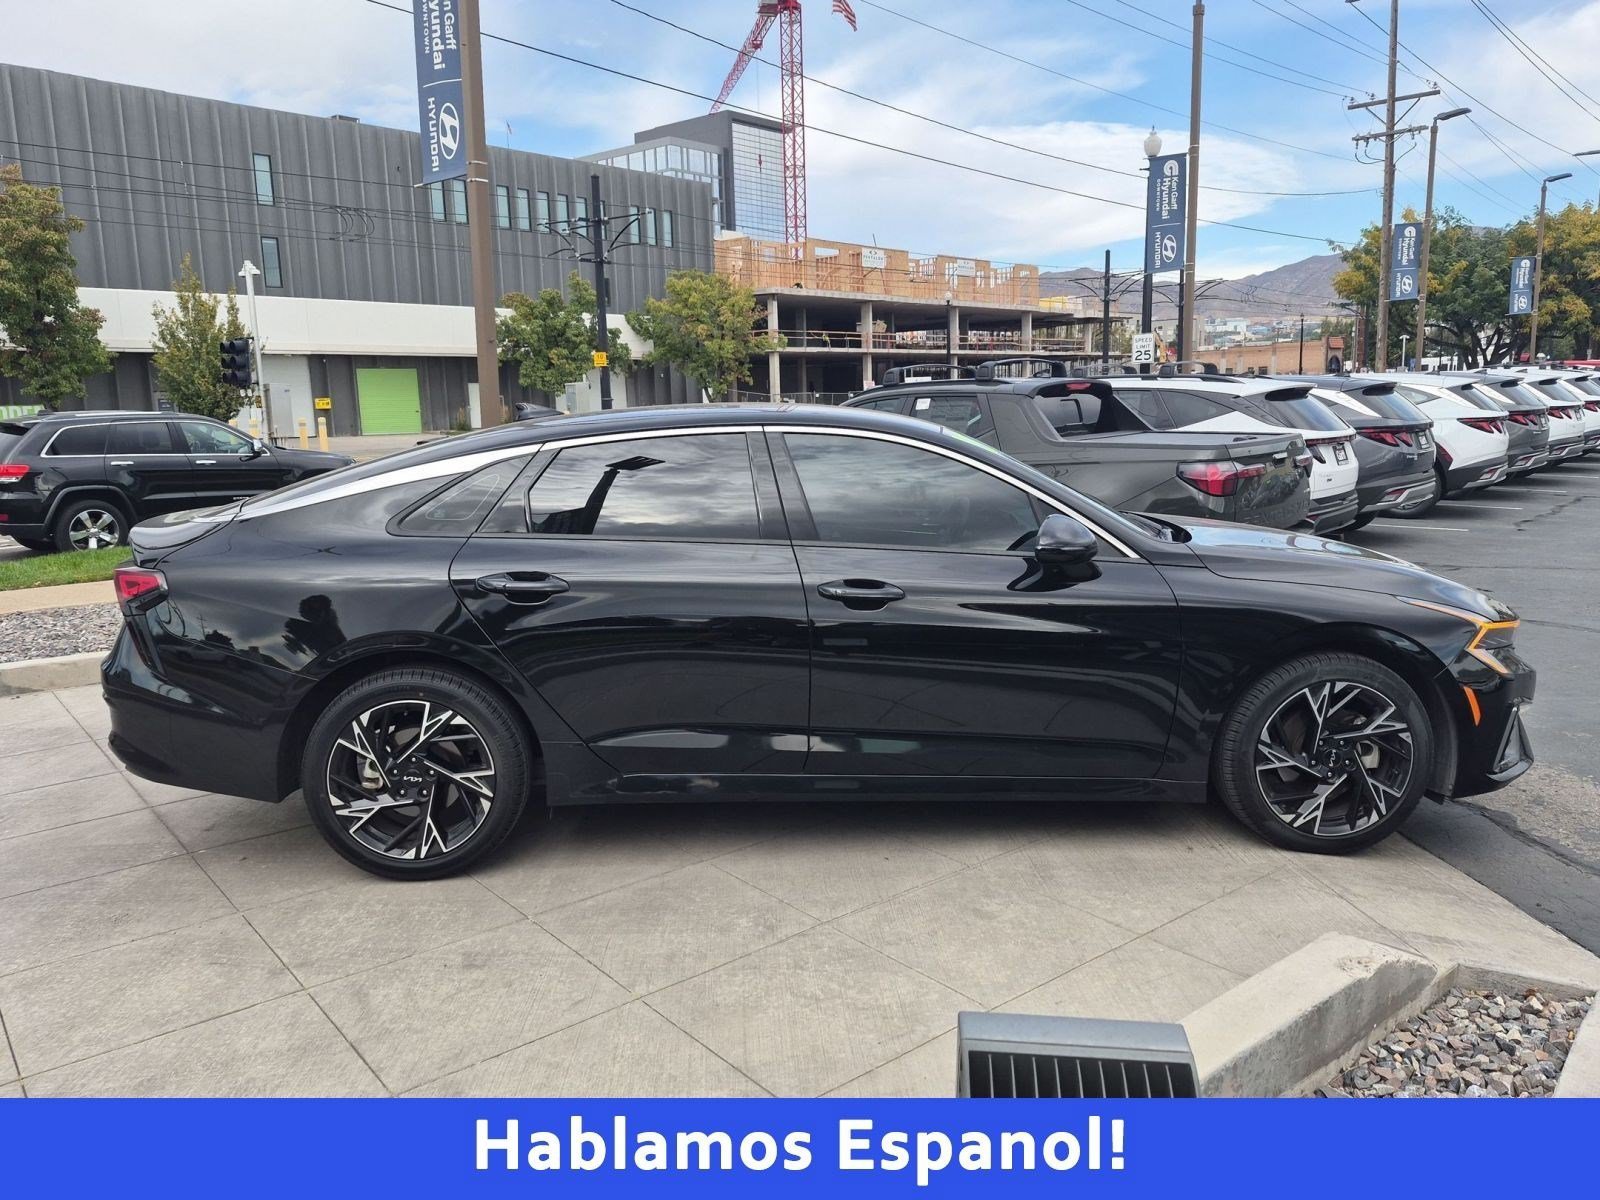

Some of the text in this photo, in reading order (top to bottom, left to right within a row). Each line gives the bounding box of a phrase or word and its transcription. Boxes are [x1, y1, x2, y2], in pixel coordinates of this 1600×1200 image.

[444, 13, 457, 50] Garff
[428, 97, 439, 172] HYUNDAI
[1161, 177, 1170, 219] Hyundai
[1135, 350, 1151, 361] 25
